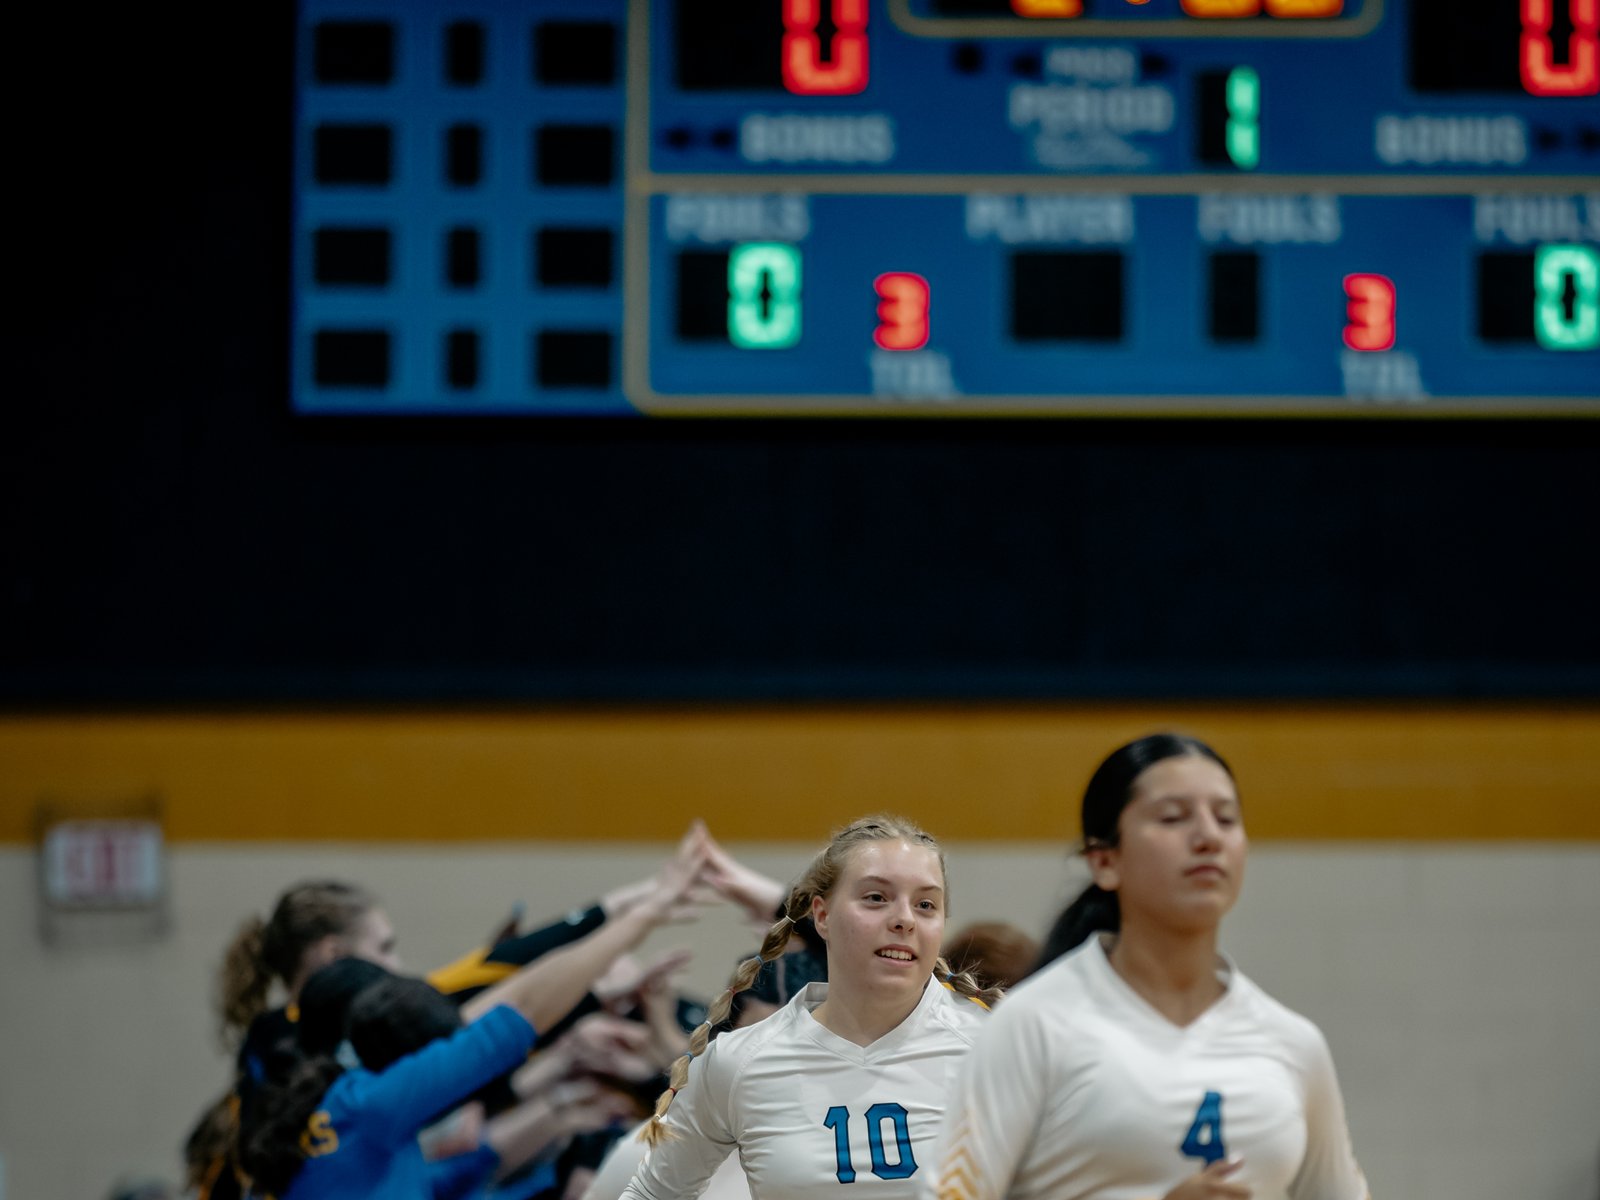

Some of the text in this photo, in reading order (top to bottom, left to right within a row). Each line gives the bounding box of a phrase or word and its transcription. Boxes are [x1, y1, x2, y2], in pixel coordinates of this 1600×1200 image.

[741, 114, 894, 163] BONUS
[1009, 83, 1174, 133] PERIOD
[1226, 66, 1260, 170] 1
[1375, 116, 1527, 164] BONUS
[665, 193, 811, 241] FOULS
[966, 193, 1133, 244] PLAYER
[1198, 194, 1342, 244] FOULS
[727, 241, 801, 350] 0
[873, 272, 930, 351] 3
[1342, 273, 1397, 352] 3
[1534, 243, 1600, 351] 0
[823, 1102, 919, 1184] 10
[1179, 1090, 1225, 1165] 4
